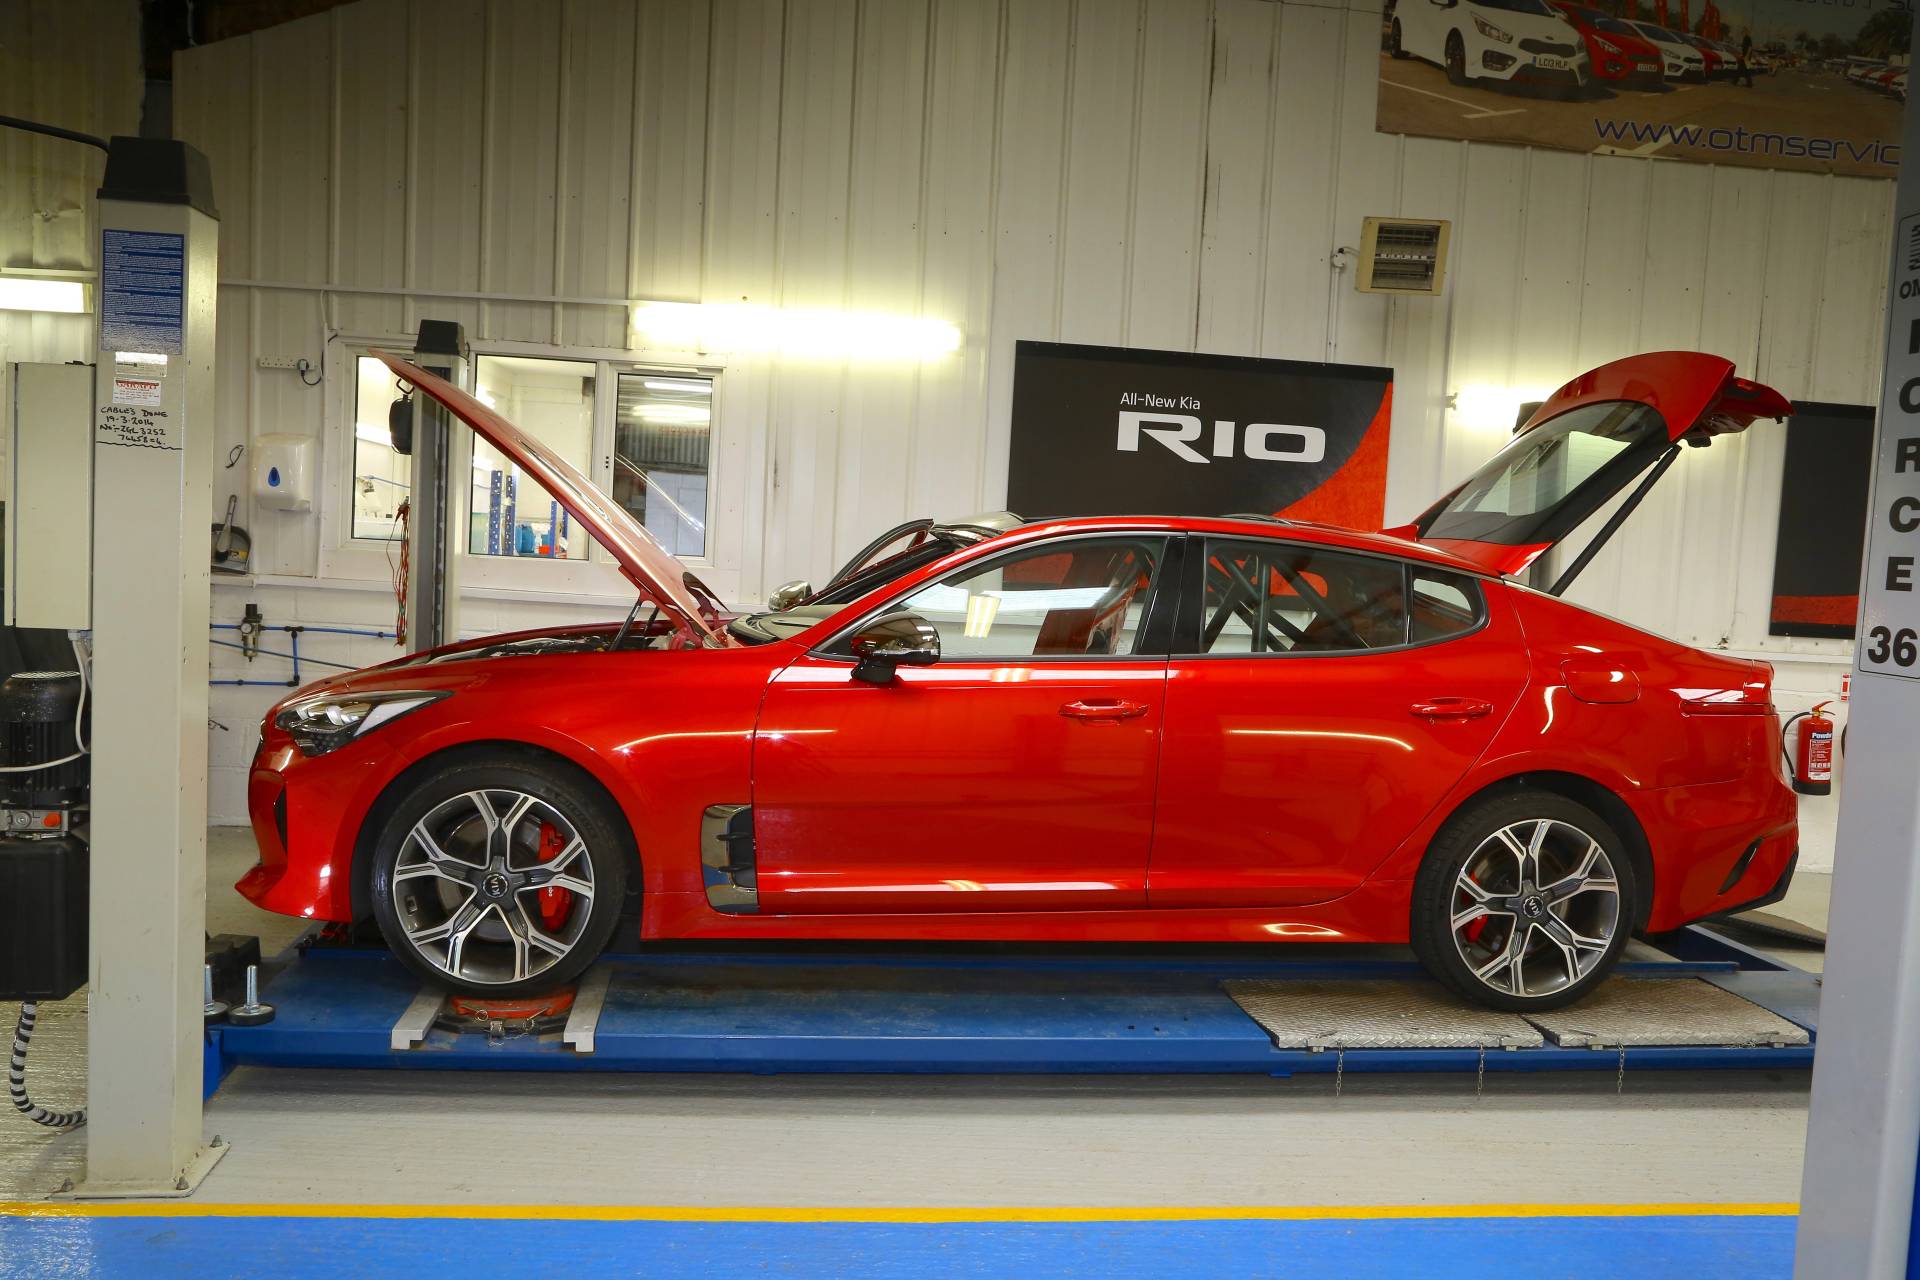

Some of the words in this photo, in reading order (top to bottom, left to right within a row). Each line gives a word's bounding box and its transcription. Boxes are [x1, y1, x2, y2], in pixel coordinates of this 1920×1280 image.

[1593, 117, 1903, 166] www.otmservic
[141, 409, 169, 418] DONE
[1120, 392, 1176, 408] All-New
[1180, 396, 1201, 410] Kia
[140, 428, 166, 436] 3252
[1117, 411, 1326, 463] RIO
[1868, 626, 1918, 667] 36
